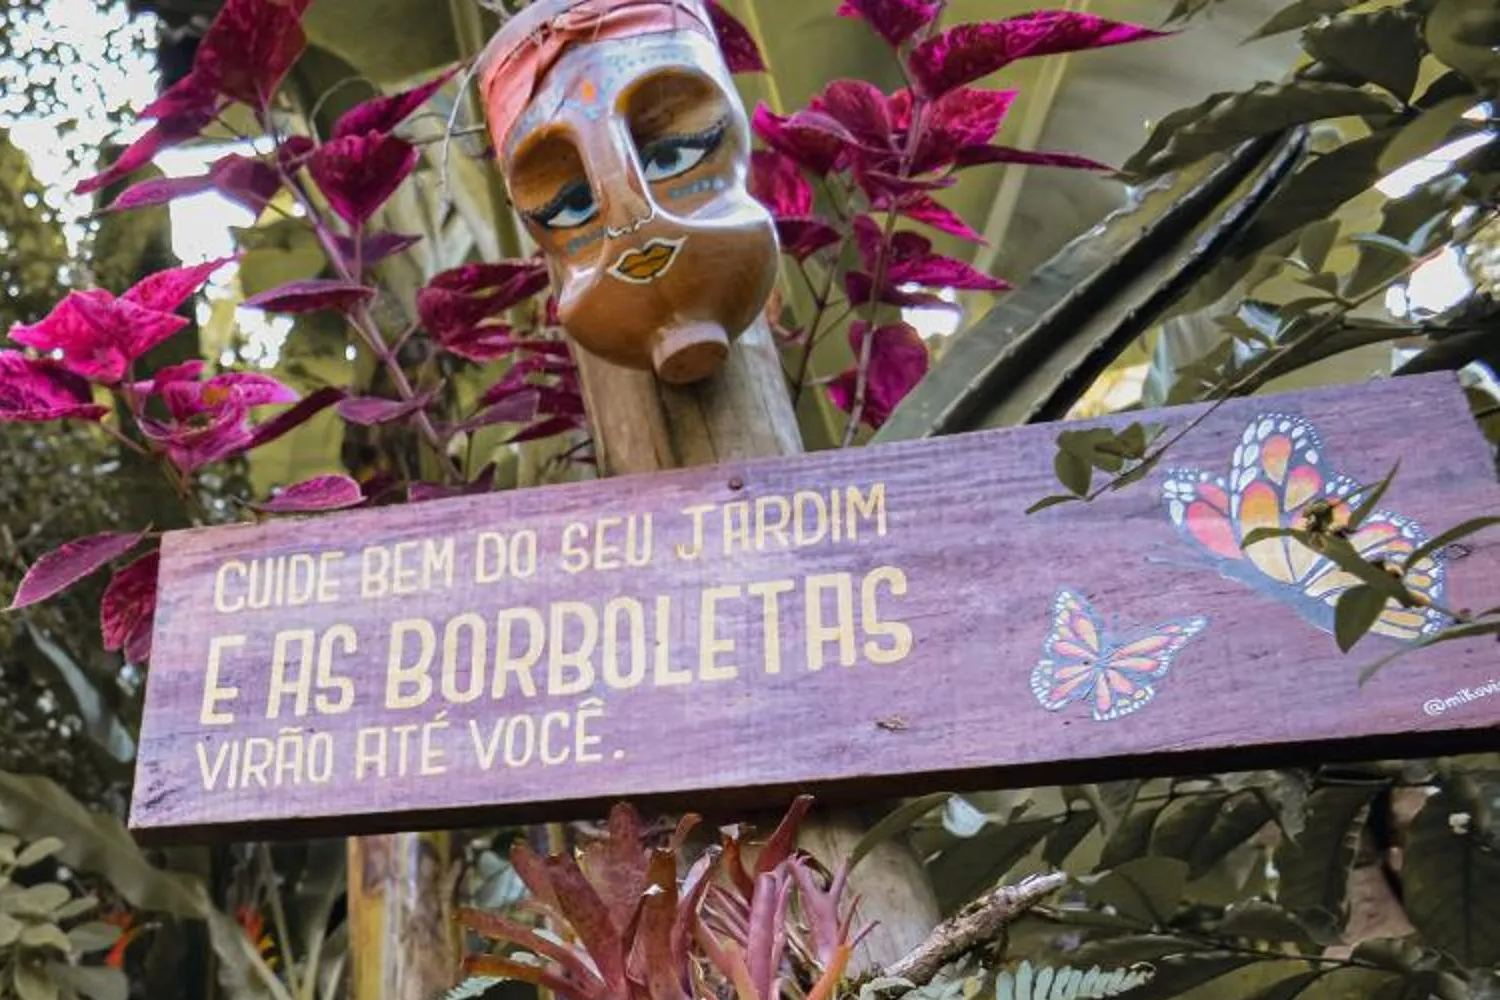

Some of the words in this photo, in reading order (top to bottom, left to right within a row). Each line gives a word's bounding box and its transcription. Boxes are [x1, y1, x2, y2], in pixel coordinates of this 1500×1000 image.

[214, 552, 344, 612] CUIDE
[361, 537, 454, 598] BEM
[475, 529, 537, 583] DO
[560, 512, 653, 574] SEU
[676, 482, 887, 560] JARDIM
[200, 635, 246, 725] E
[266, 623, 357, 719] AS
[385, 566, 914, 709] BORBOLETAS
[196, 728, 334, 791] VIRÃO
[354, 711, 451, 779] ATÉ
[468, 697, 625, 772] VOCÊ.
